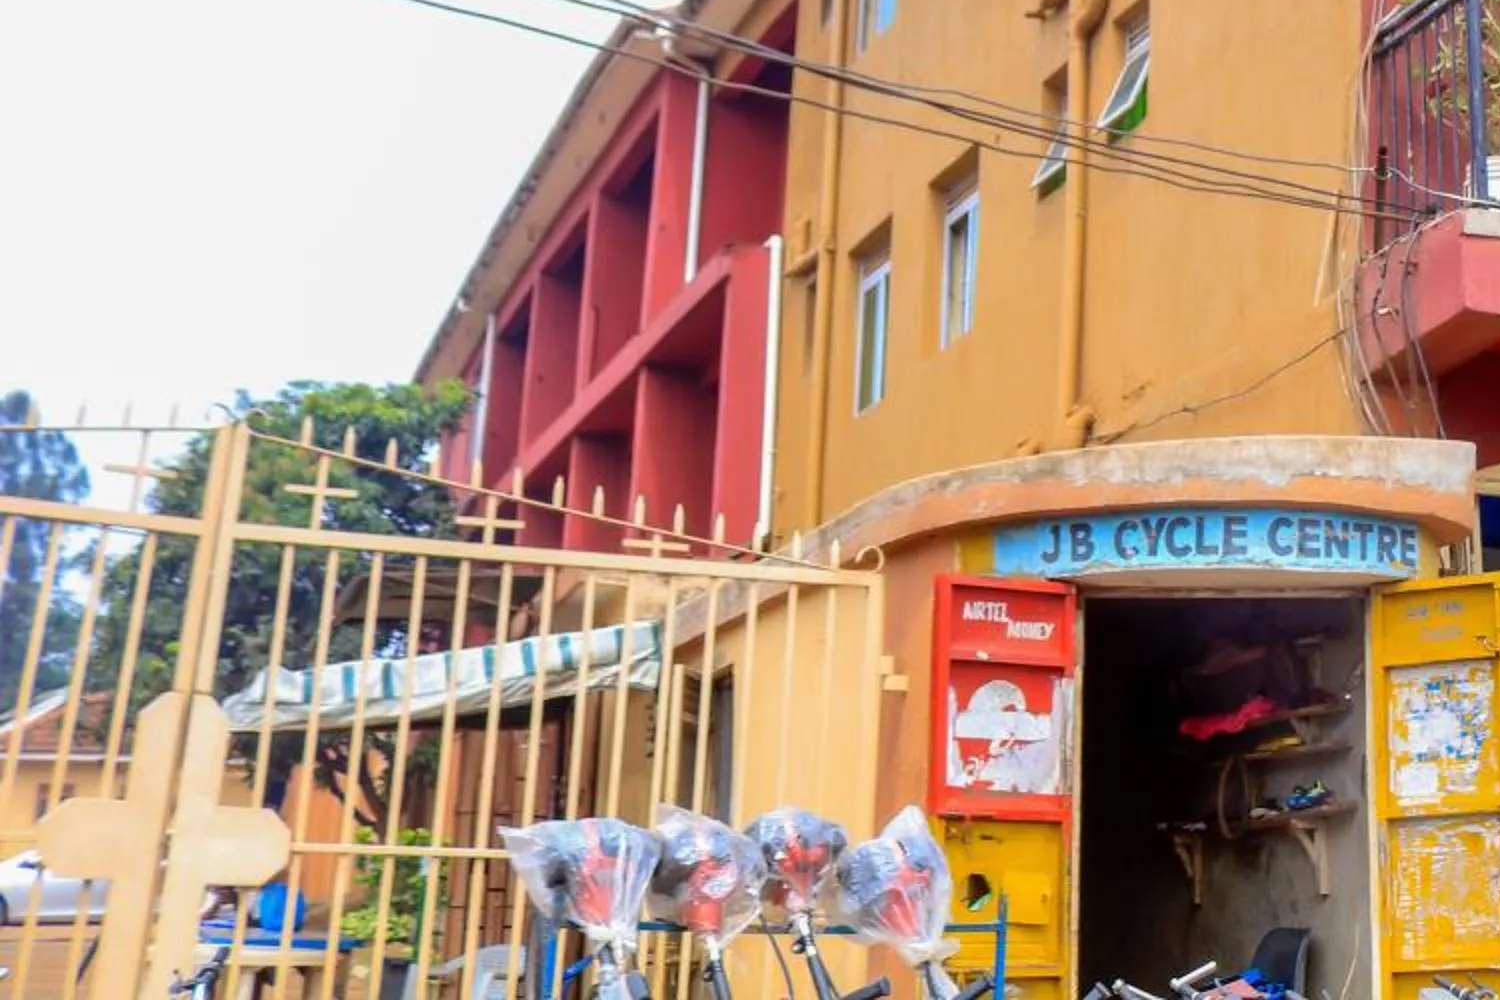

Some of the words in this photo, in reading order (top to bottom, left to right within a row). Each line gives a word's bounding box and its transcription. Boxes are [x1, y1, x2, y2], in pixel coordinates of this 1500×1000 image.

[1040, 521, 1095, 564] JB
[1113, 515, 1249, 561] CYCLE
[1267, 516, 1419, 568] CENTRE
[963, 600, 1009, 623] AIRTEL
[1007, 619, 1056, 641] MONEY
